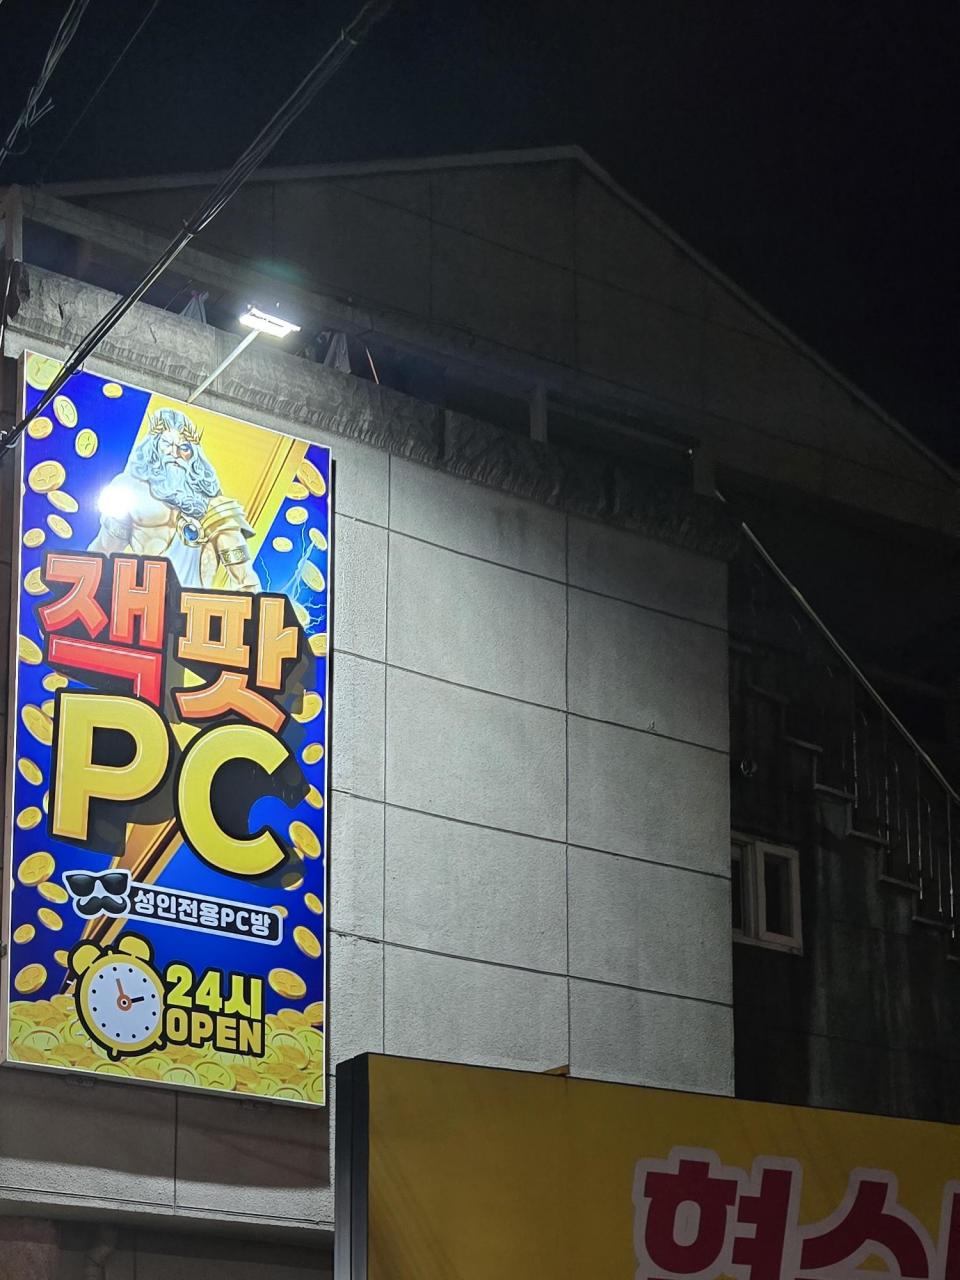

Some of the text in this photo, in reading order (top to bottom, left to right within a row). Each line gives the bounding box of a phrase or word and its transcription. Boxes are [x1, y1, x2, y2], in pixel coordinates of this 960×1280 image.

[38, 553, 299, 733] 잭팟
[51, 692, 290, 876] PC
[133, 889, 272, 937] 성인전용PC방
[165, 964, 262, 1020] 24시
[165, 1007, 262, 1055] OPEN
